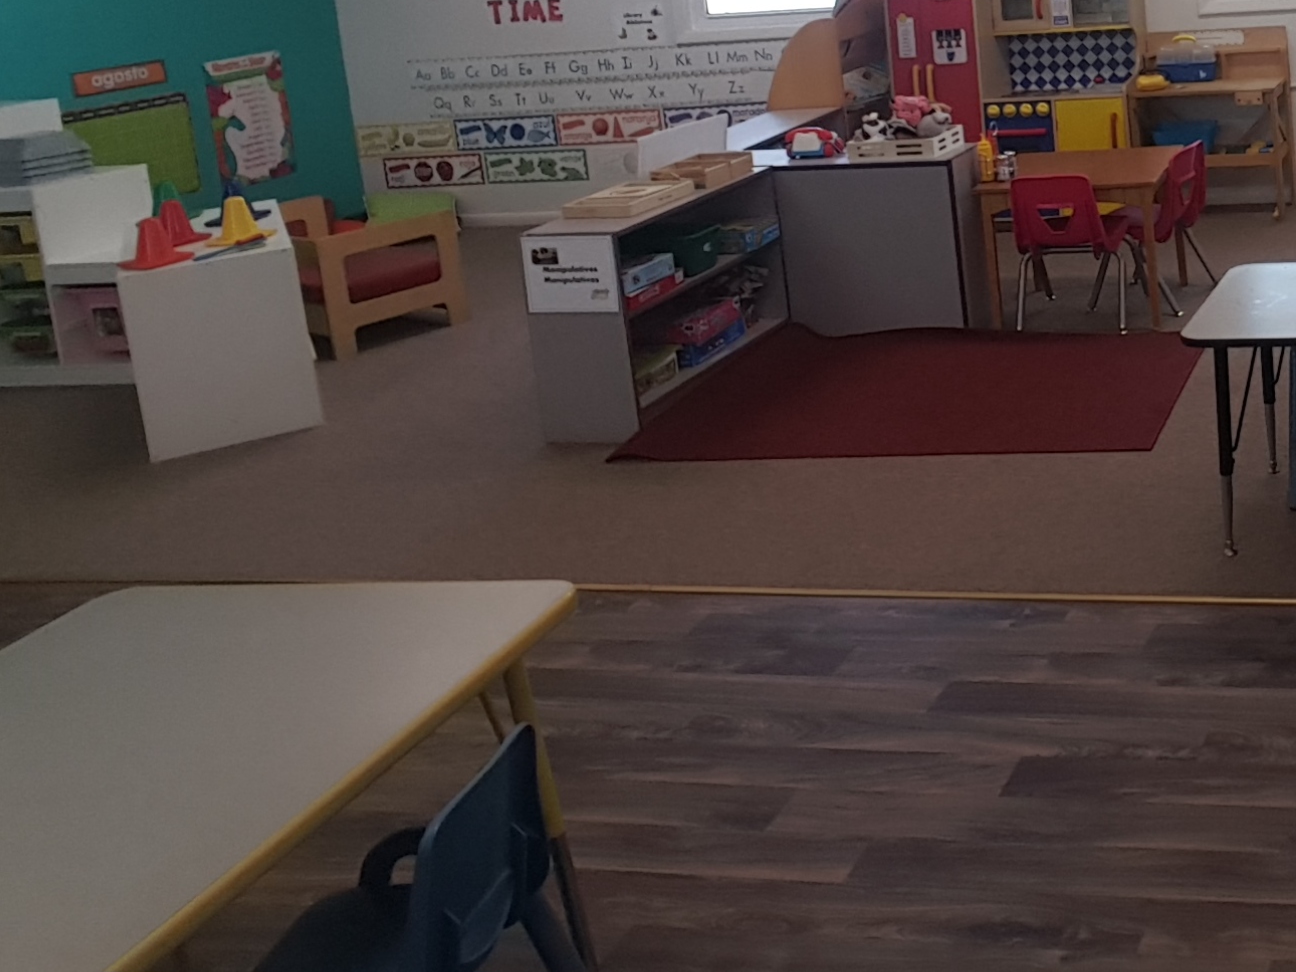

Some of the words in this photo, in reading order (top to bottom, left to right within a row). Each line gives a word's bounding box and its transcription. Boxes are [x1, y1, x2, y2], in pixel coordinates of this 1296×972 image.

[91, 66, 149, 89] agosto
[416, 69, 431, 81] Aa
[440, 66, 456, 79] Bb
[465, 65, 481, 78] Cc
[490, 63, 508, 77] Dd
[518, 62, 533, 76] Ee
[568, 60, 588, 75] Gg
[598, 58, 615, 71] Hh
[648, 55, 659, 71] Jj
[675, 53, 693, 66] Kk
[726, 50, 749, 63] Mm
[754, 48, 774, 62] Nn
[433, 96, 452, 112] Qq
[489, 94, 503, 107] Ss
[515, 92, 526, 106] Tt
[538, 92, 555, 105] Uu
[575, 90, 592, 102] Vv
[609, 88, 634, 101] Ww
[648, 85, 665, 99] Xx
[688, 83, 705, 102] Yy
[728, 80, 746, 94] Zz
